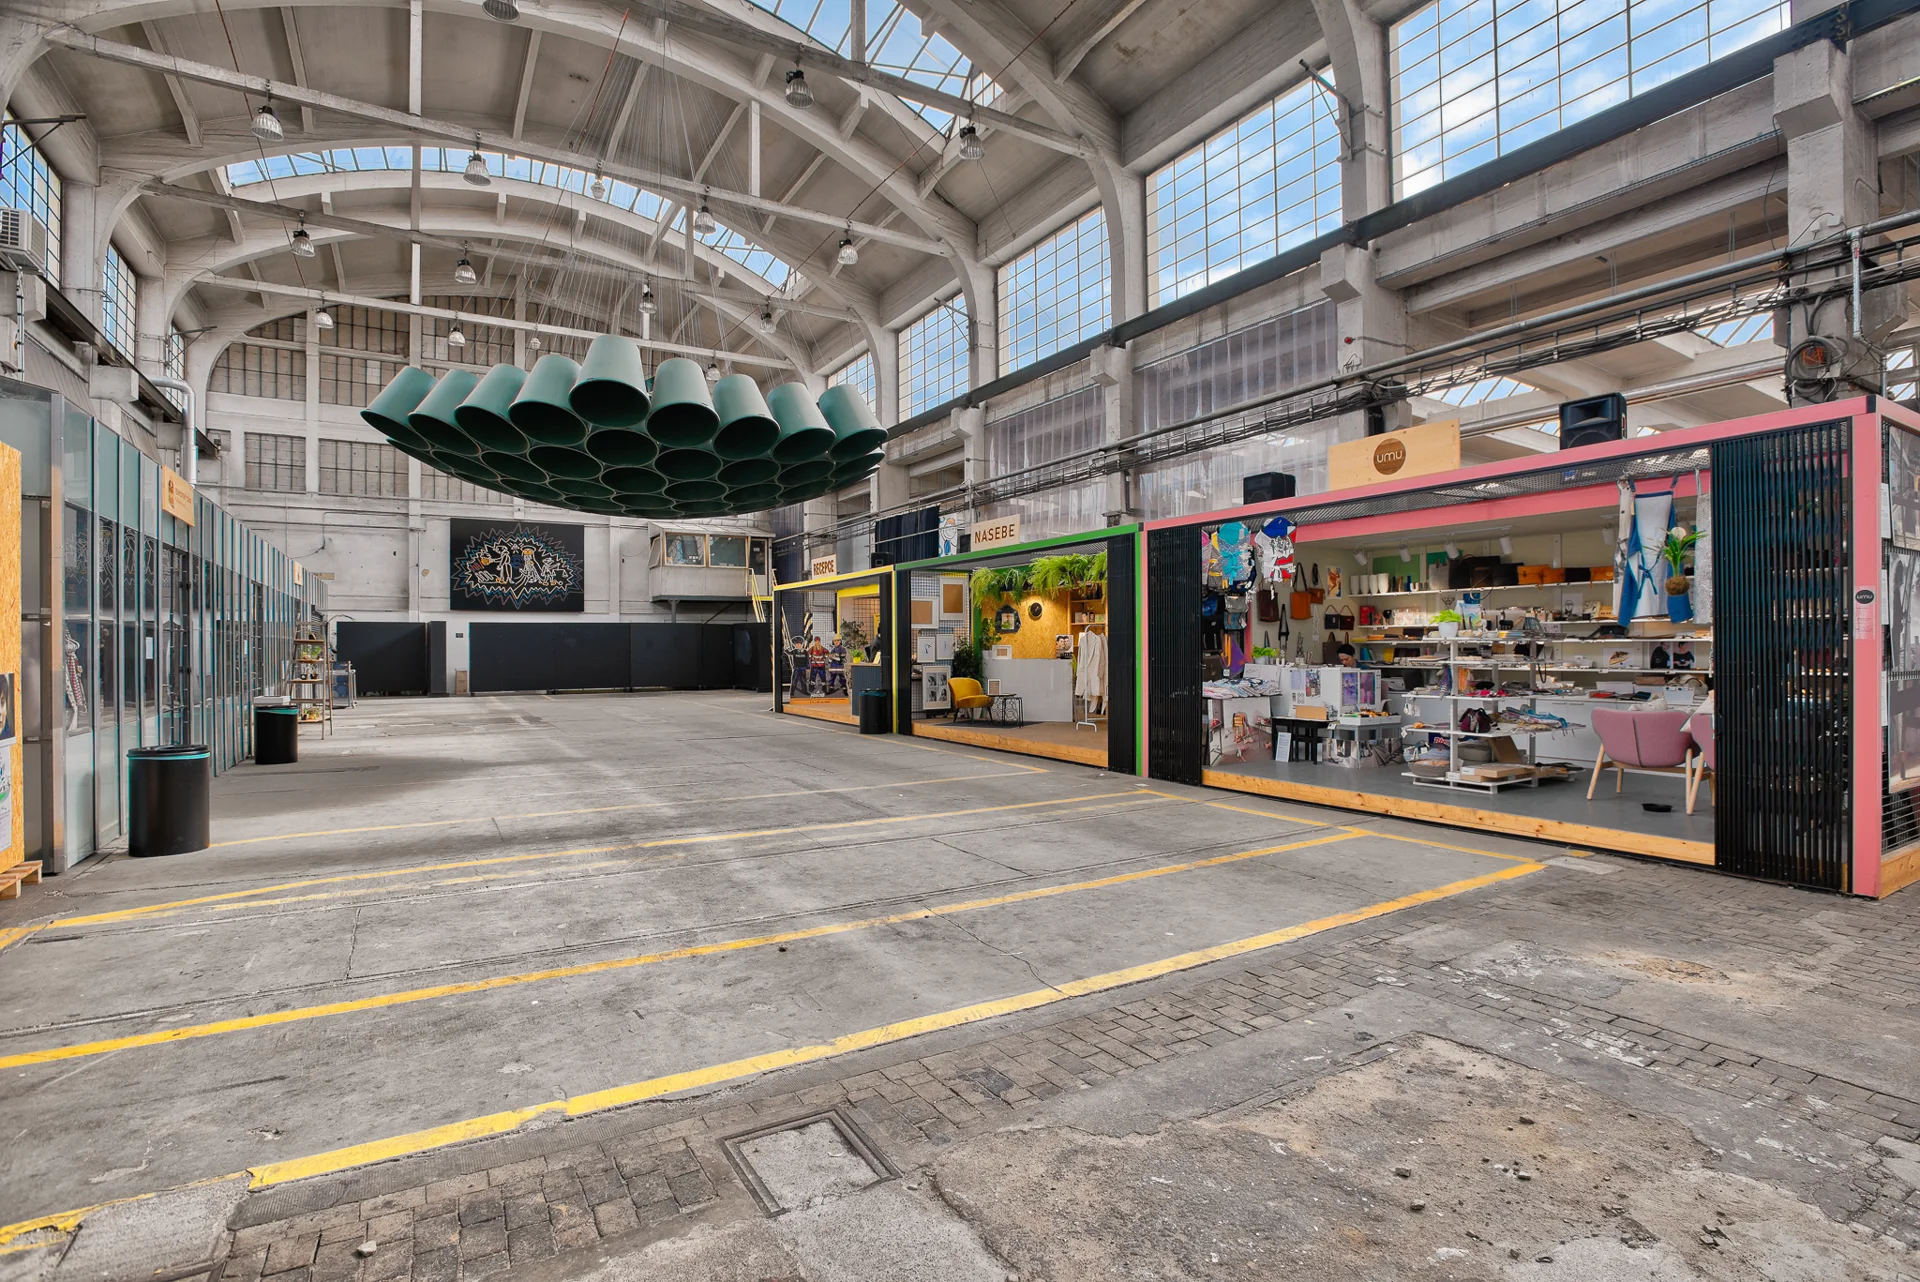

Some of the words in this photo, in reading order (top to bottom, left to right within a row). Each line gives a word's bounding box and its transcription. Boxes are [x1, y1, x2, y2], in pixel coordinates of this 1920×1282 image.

[1376, 450, 1402, 463] umu
[975, 524, 1015, 543] NASEBE
[813, 560, 834, 576] RECEPCE
